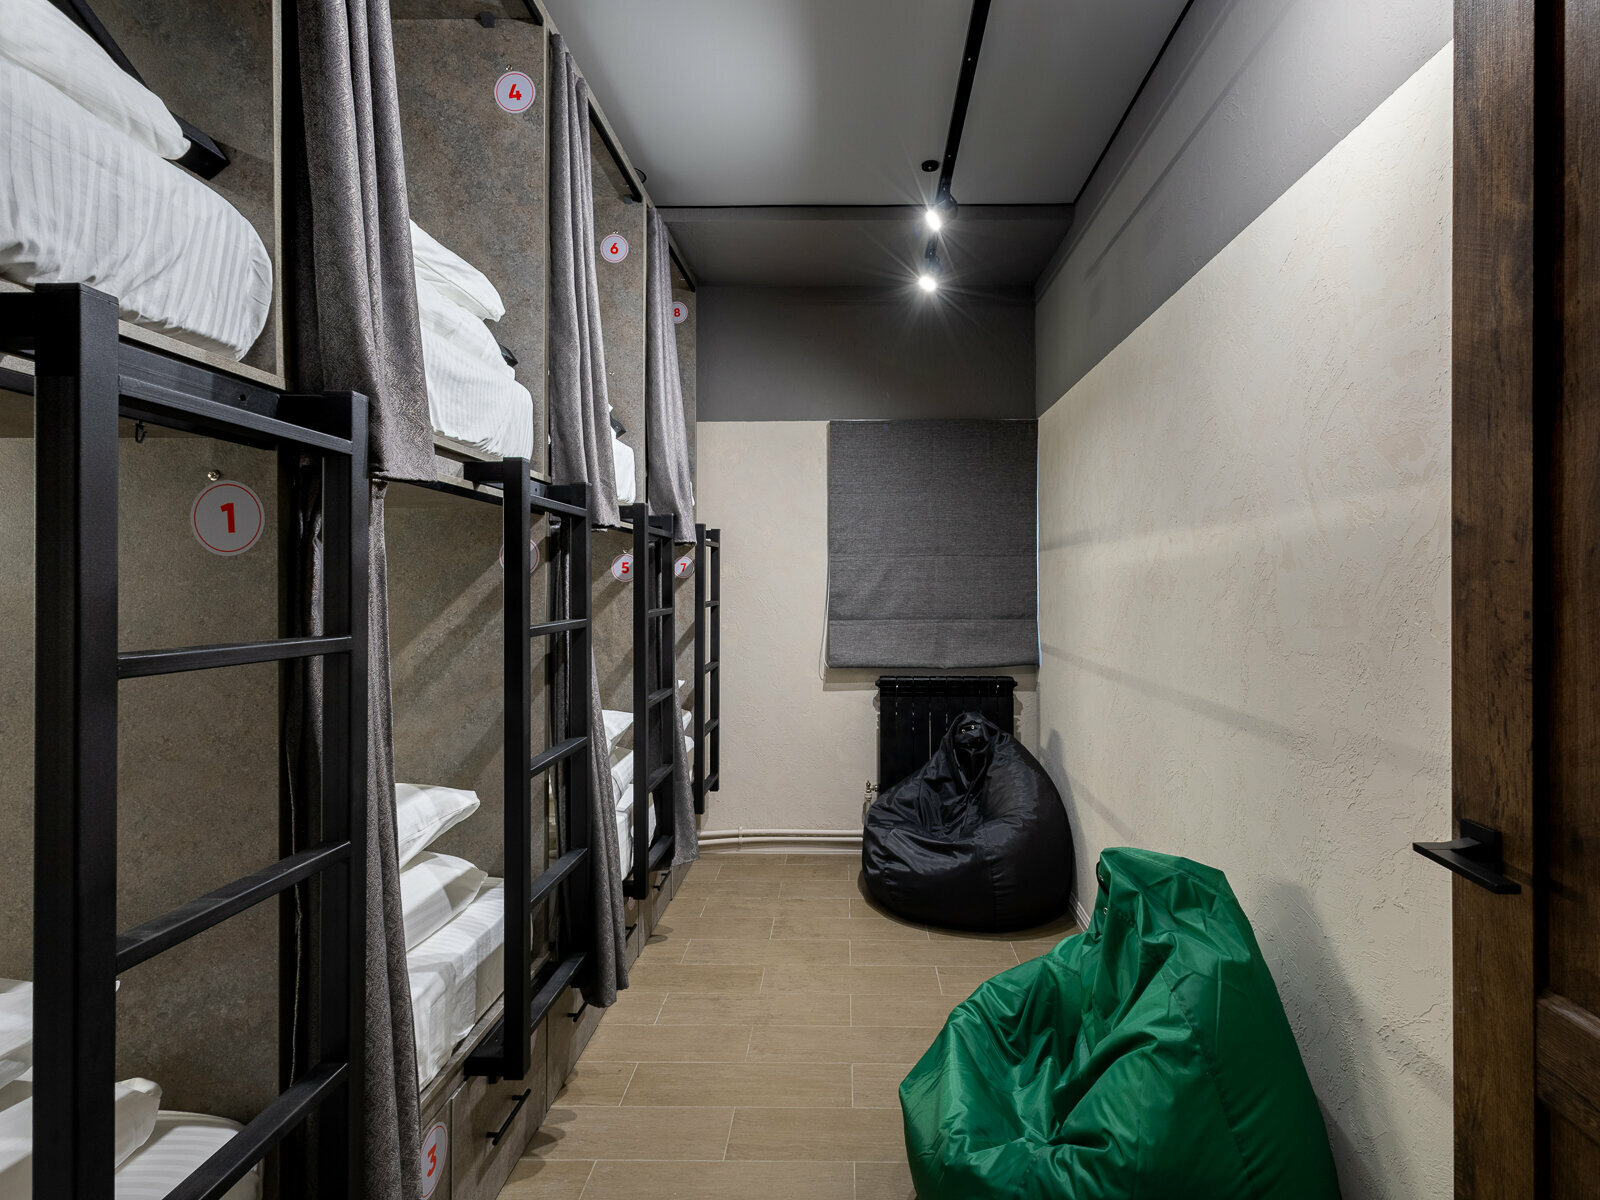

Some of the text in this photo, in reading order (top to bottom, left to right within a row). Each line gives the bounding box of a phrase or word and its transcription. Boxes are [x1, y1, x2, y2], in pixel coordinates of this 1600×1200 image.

[508, 84, 522, 101] 4
[610, 242, 619, 254] 6
[673, 308, 680, 318] 8
[221, 503, 236, 533] 1
[621, 562, 630, 574] 5
[680, 562, 687, 572] 7
[427, 1144, 437, 1177] 3
